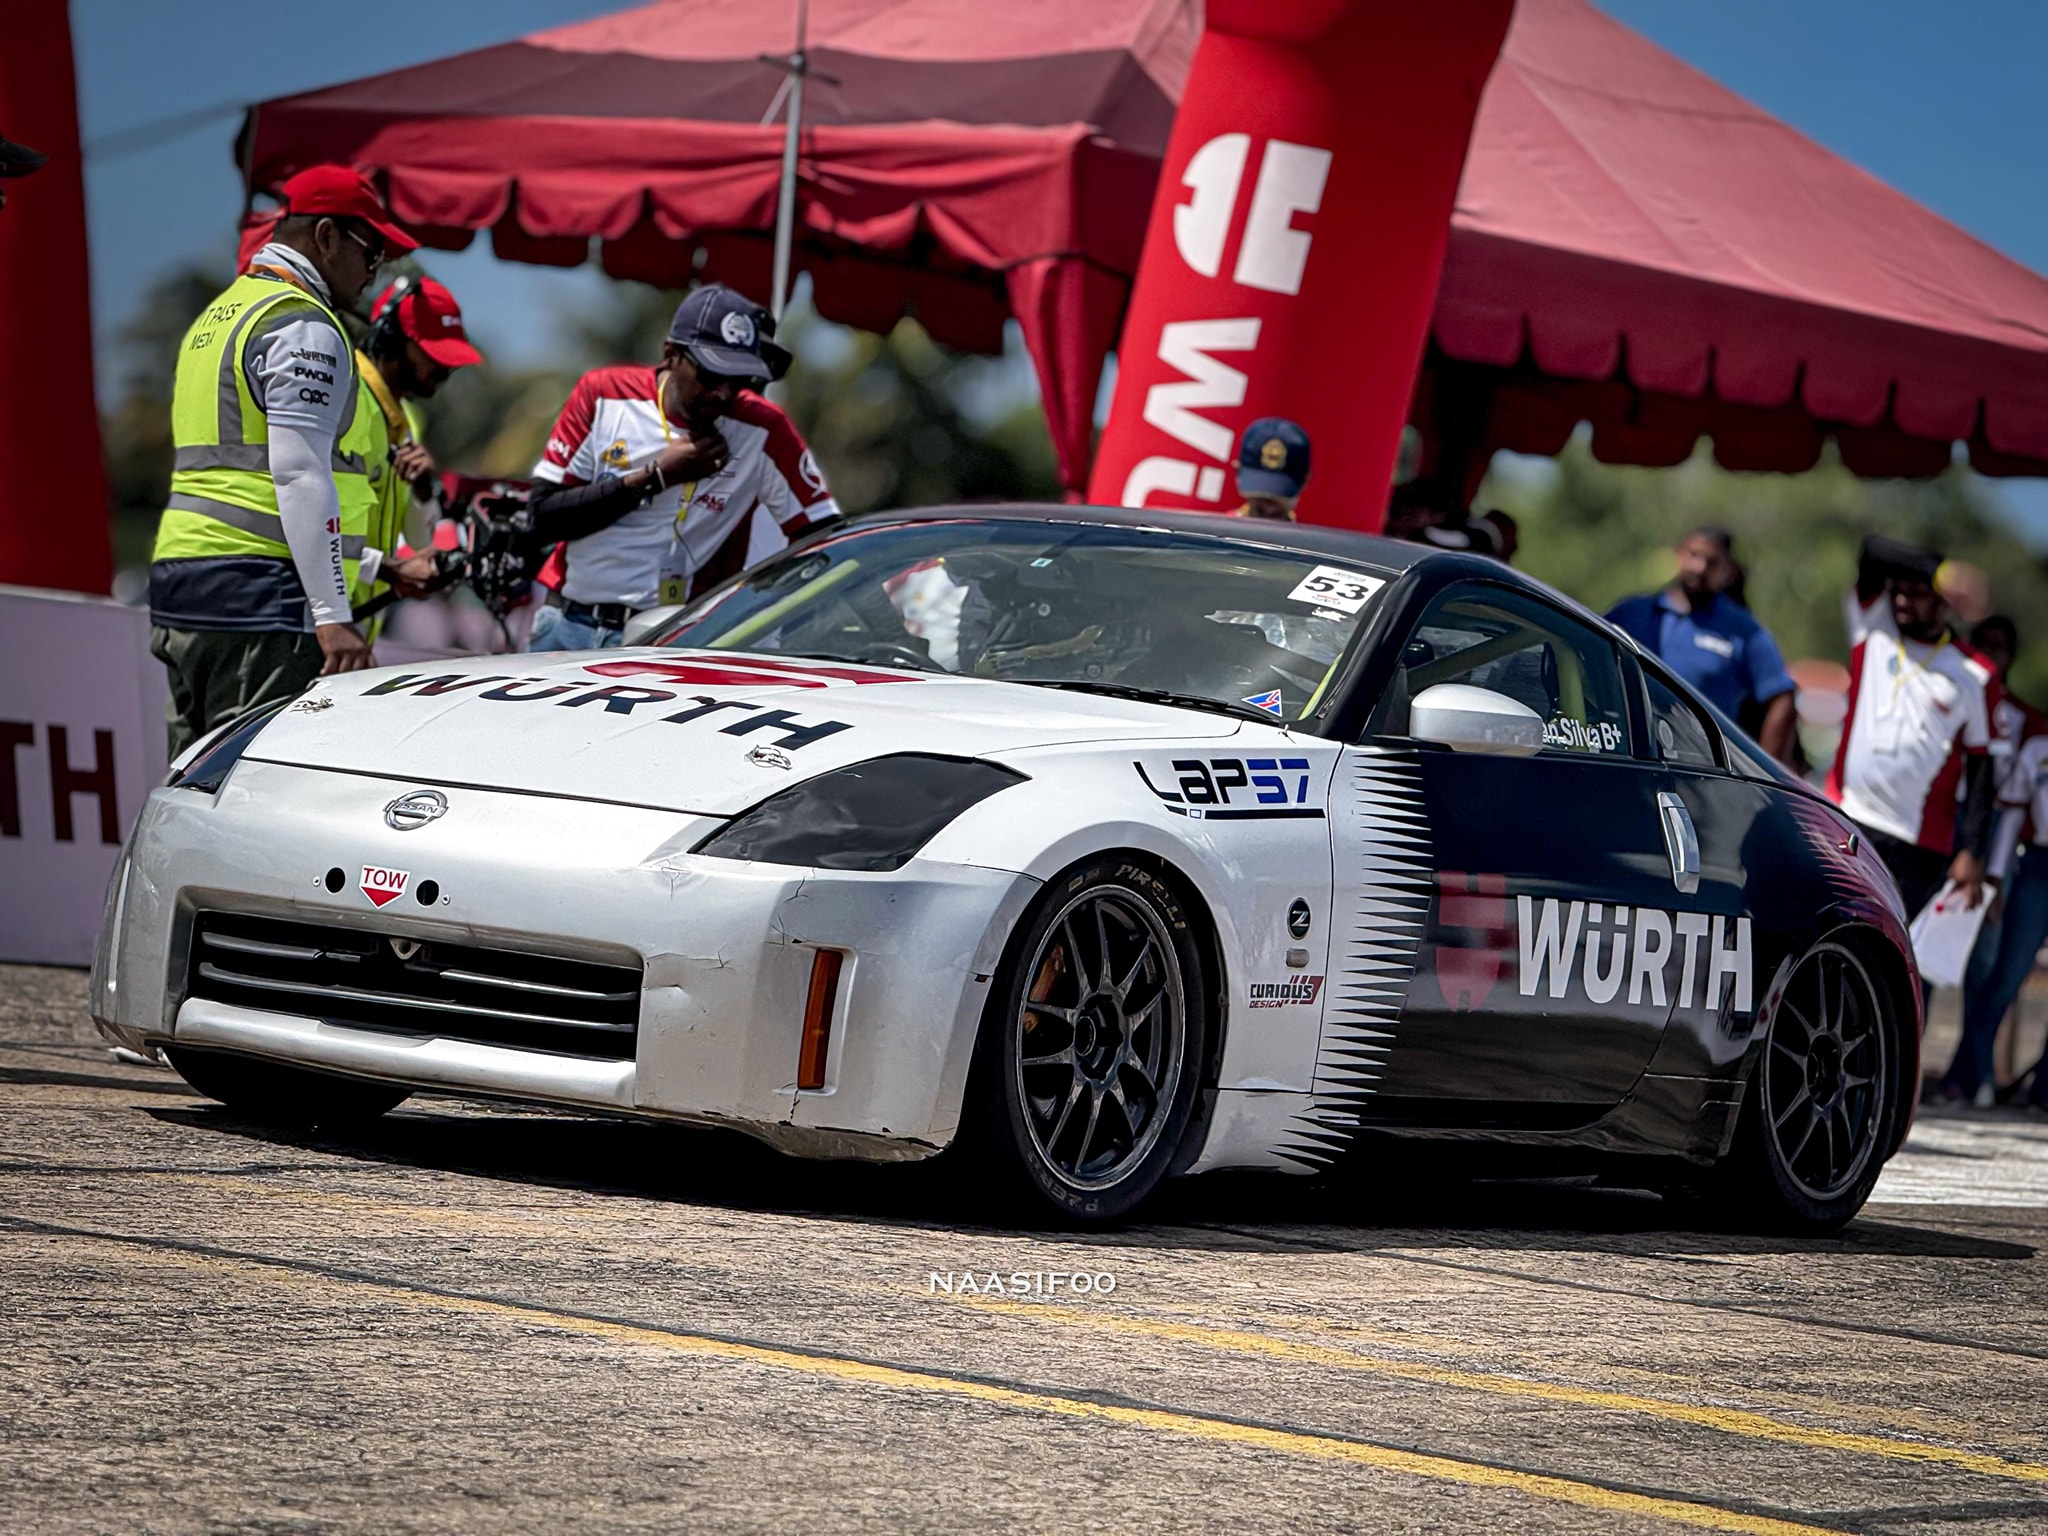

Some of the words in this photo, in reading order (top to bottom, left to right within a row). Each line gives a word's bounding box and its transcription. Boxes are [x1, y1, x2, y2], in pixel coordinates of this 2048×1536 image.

[1303, 575, 1370, 601] 53
[361, 673, 856, 751] WÜRTH
[1560, 717, 1602, 749] Silva
[393, 802, 438, 815] NISSAN
[363, 867, 409, 889] TOW
[1516, 895, 1753, 1013] WÜRTH
[1249, 983, 1314, 999] CURIOUS
[1248, 999, 1285, 1009] DESIGN
